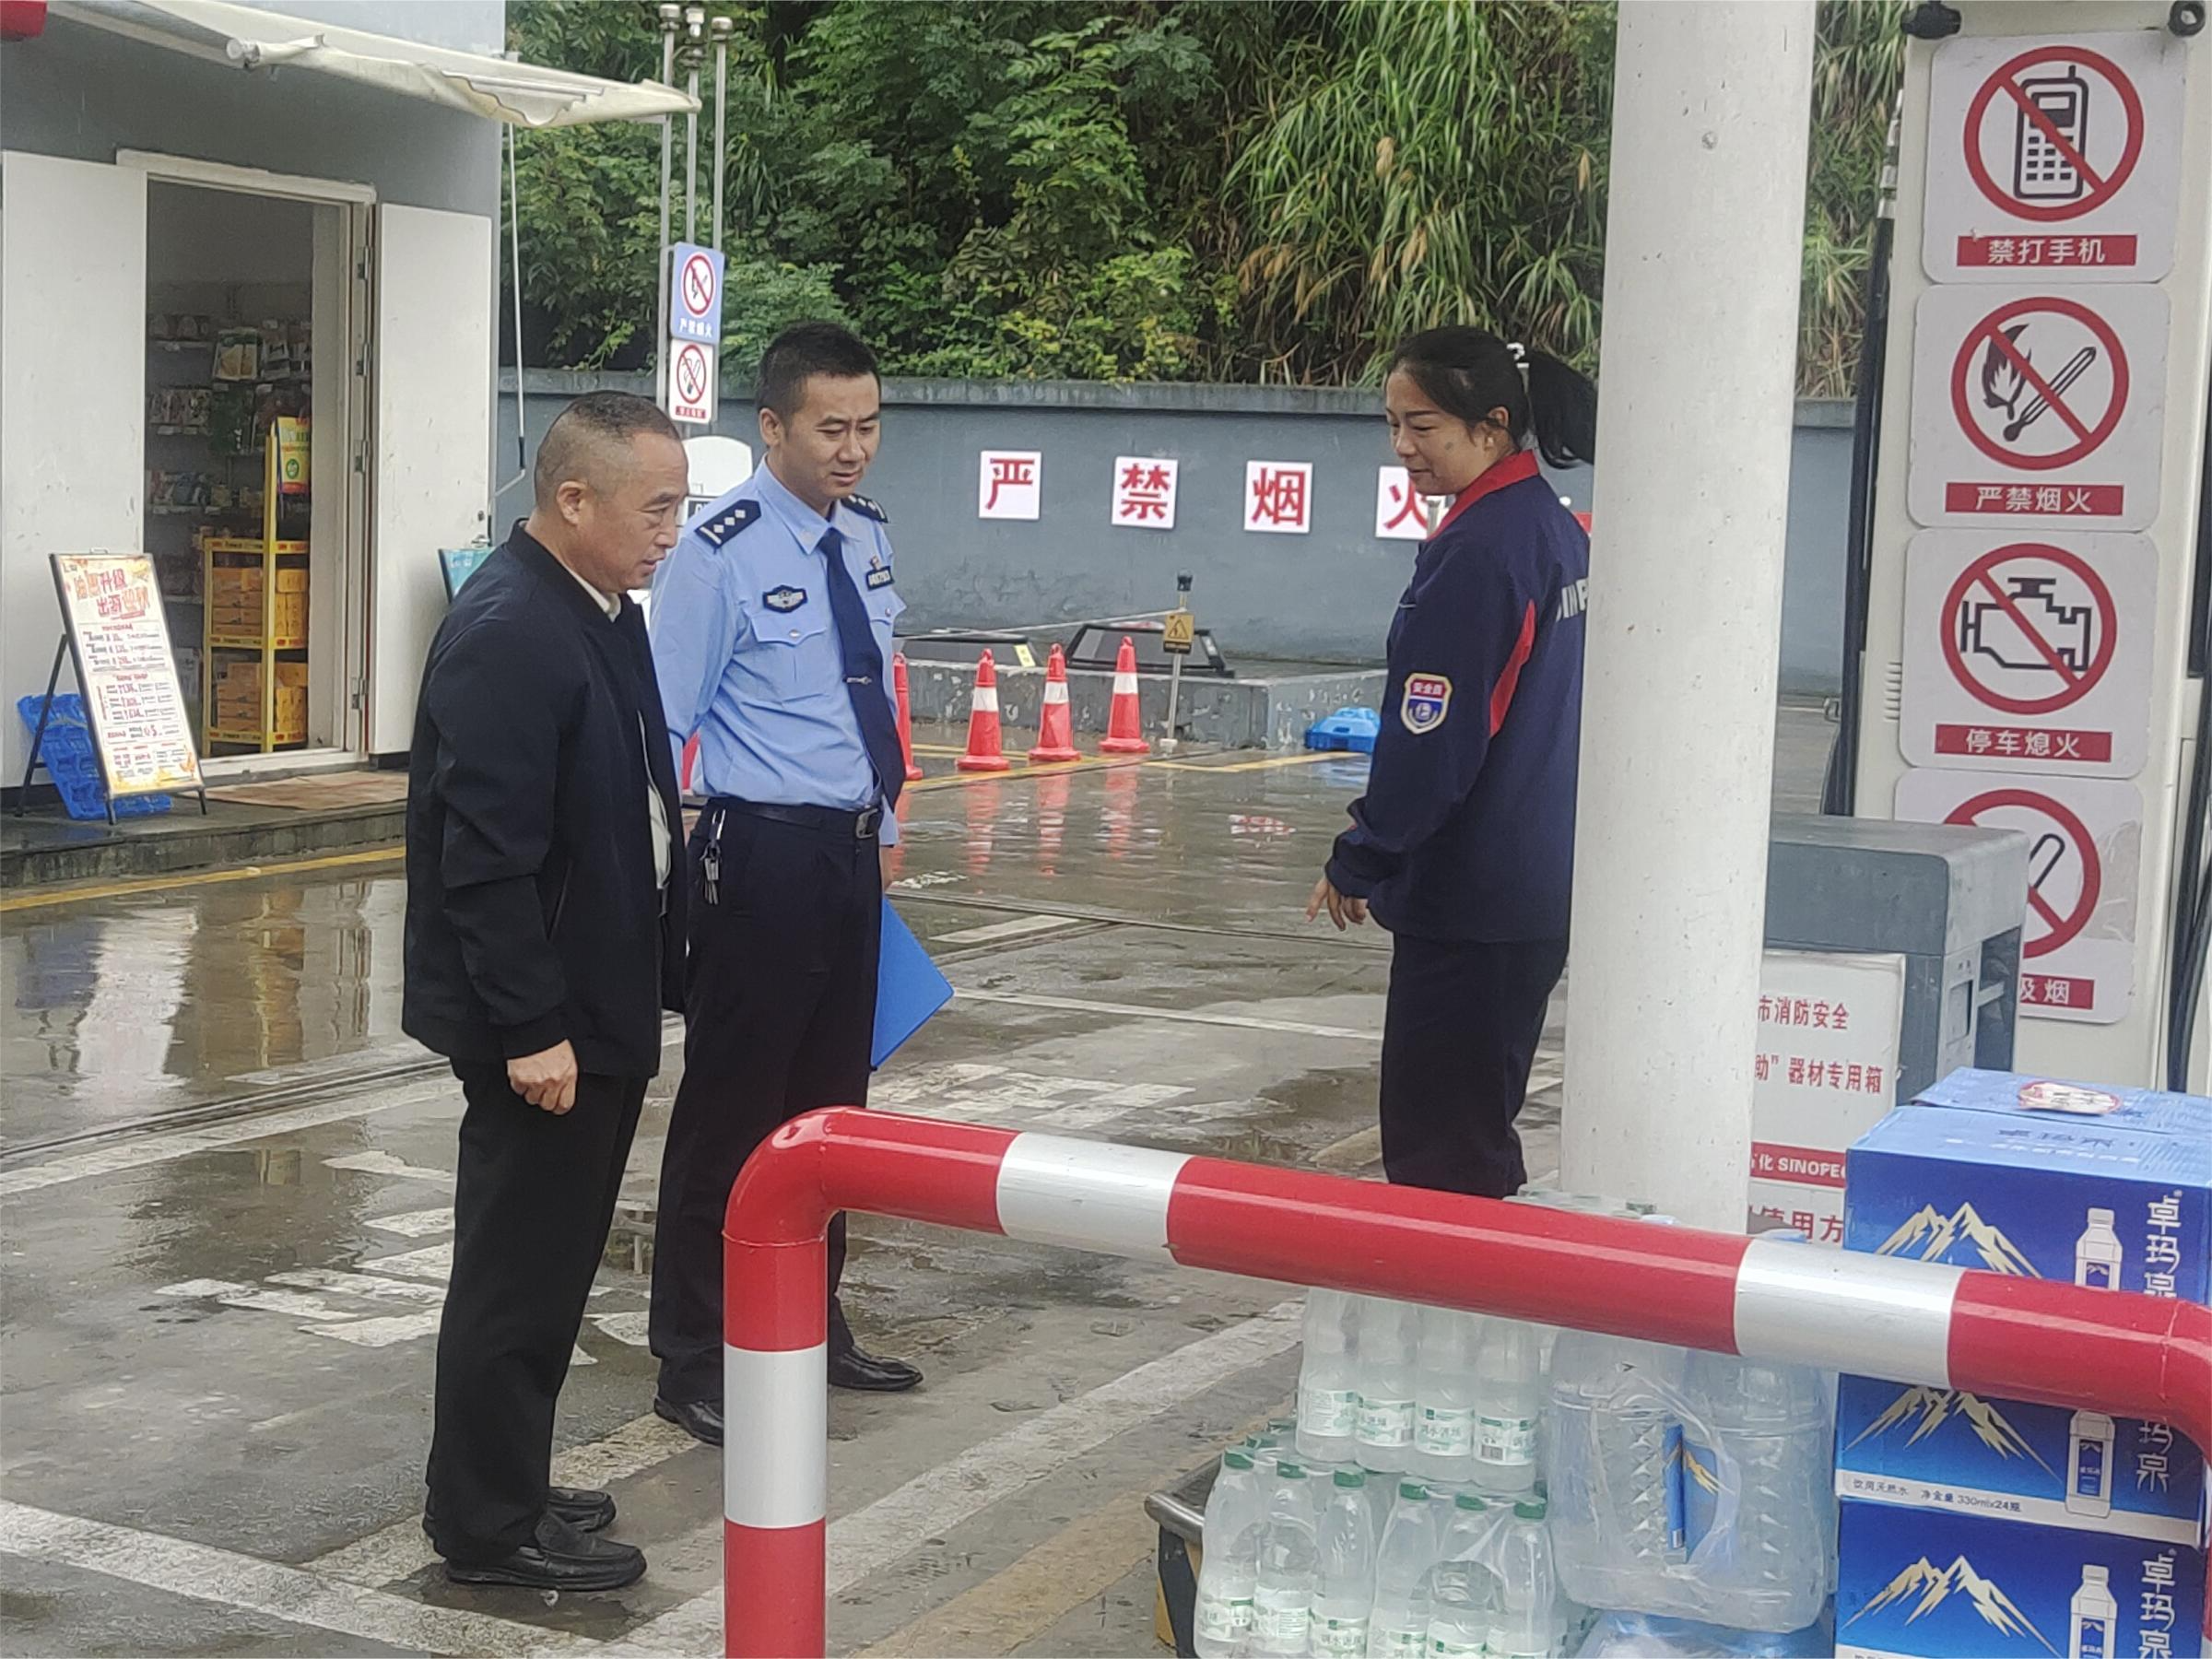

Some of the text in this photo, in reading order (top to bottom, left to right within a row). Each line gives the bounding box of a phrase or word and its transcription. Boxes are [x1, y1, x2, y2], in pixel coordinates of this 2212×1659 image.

[1988, 239, 2105, 264] 禁打手机
[1976, 487, 2091, 512] 严禁烟火
[1966, 729, 2080, 758] 停车熄火
[1758, 994, 1849, 1030] 市消防安全
[2144, 1194, 2181, 1298] 卓玛泉
[1921, 1489, 1954, 1503] 净含量
[2138, 1553, 2176, 1659] 卓玛泉
